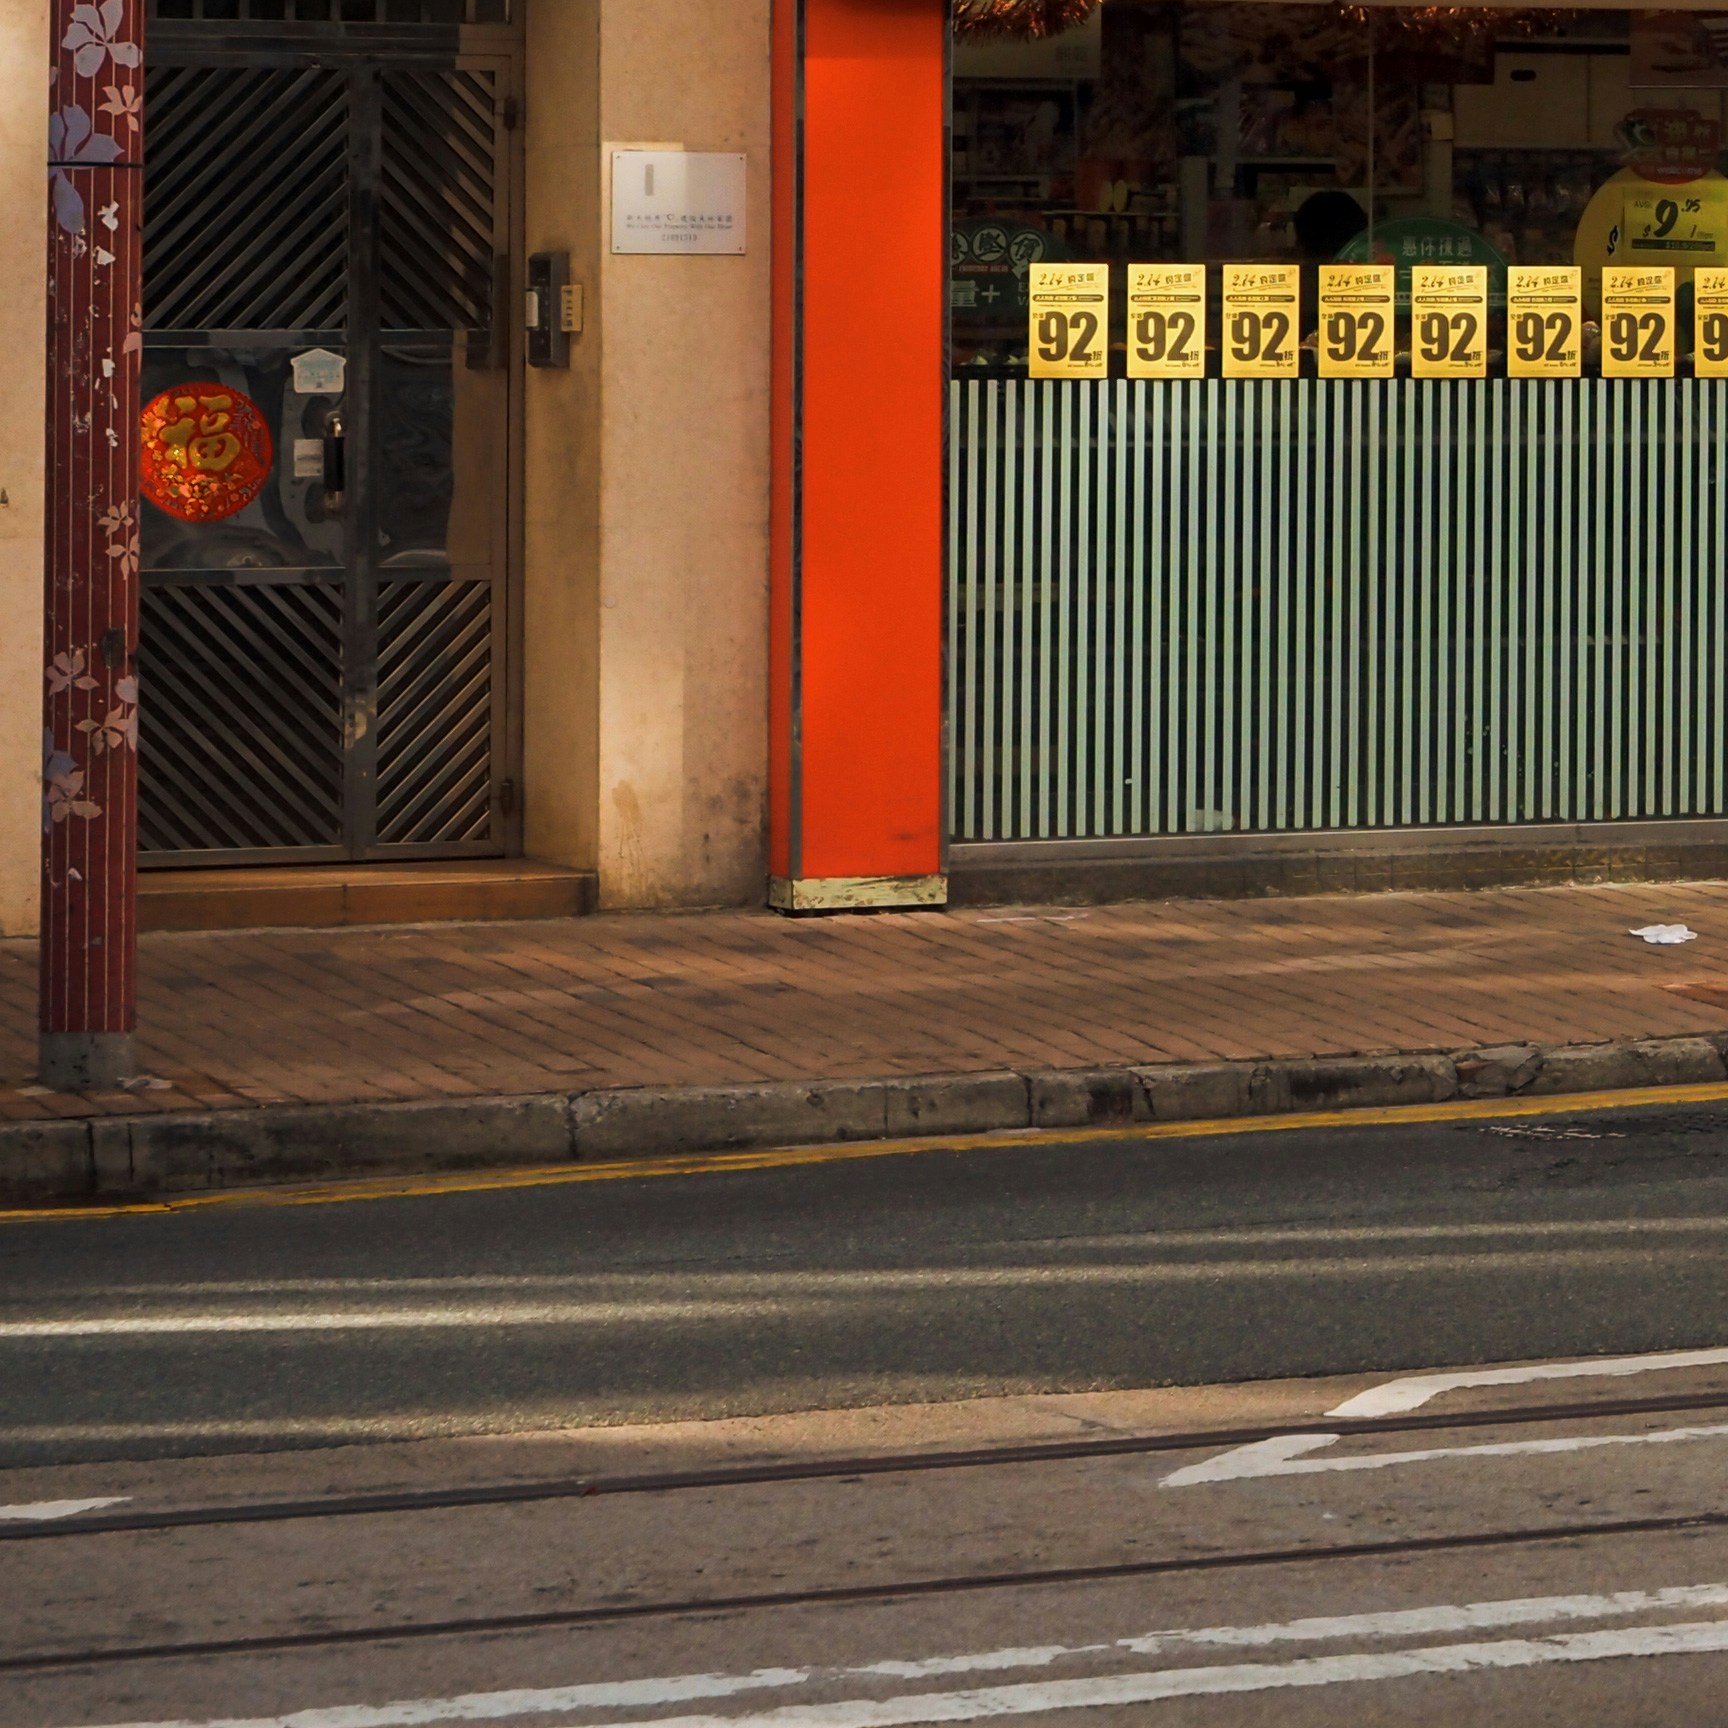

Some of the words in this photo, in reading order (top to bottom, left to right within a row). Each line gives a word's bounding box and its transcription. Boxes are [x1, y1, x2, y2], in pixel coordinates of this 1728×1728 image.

[1038, 311, 1098, 362] 92
[1136, 311, 1195, 362] 92
[1231, 312, 1290, 362] 92
[1327, 312, 1385, 362] 92
[1420, 312, 1478, 362] 92
[1516, 312, 1572, 362] 92
[1610, 312, 1666, 362] 92
